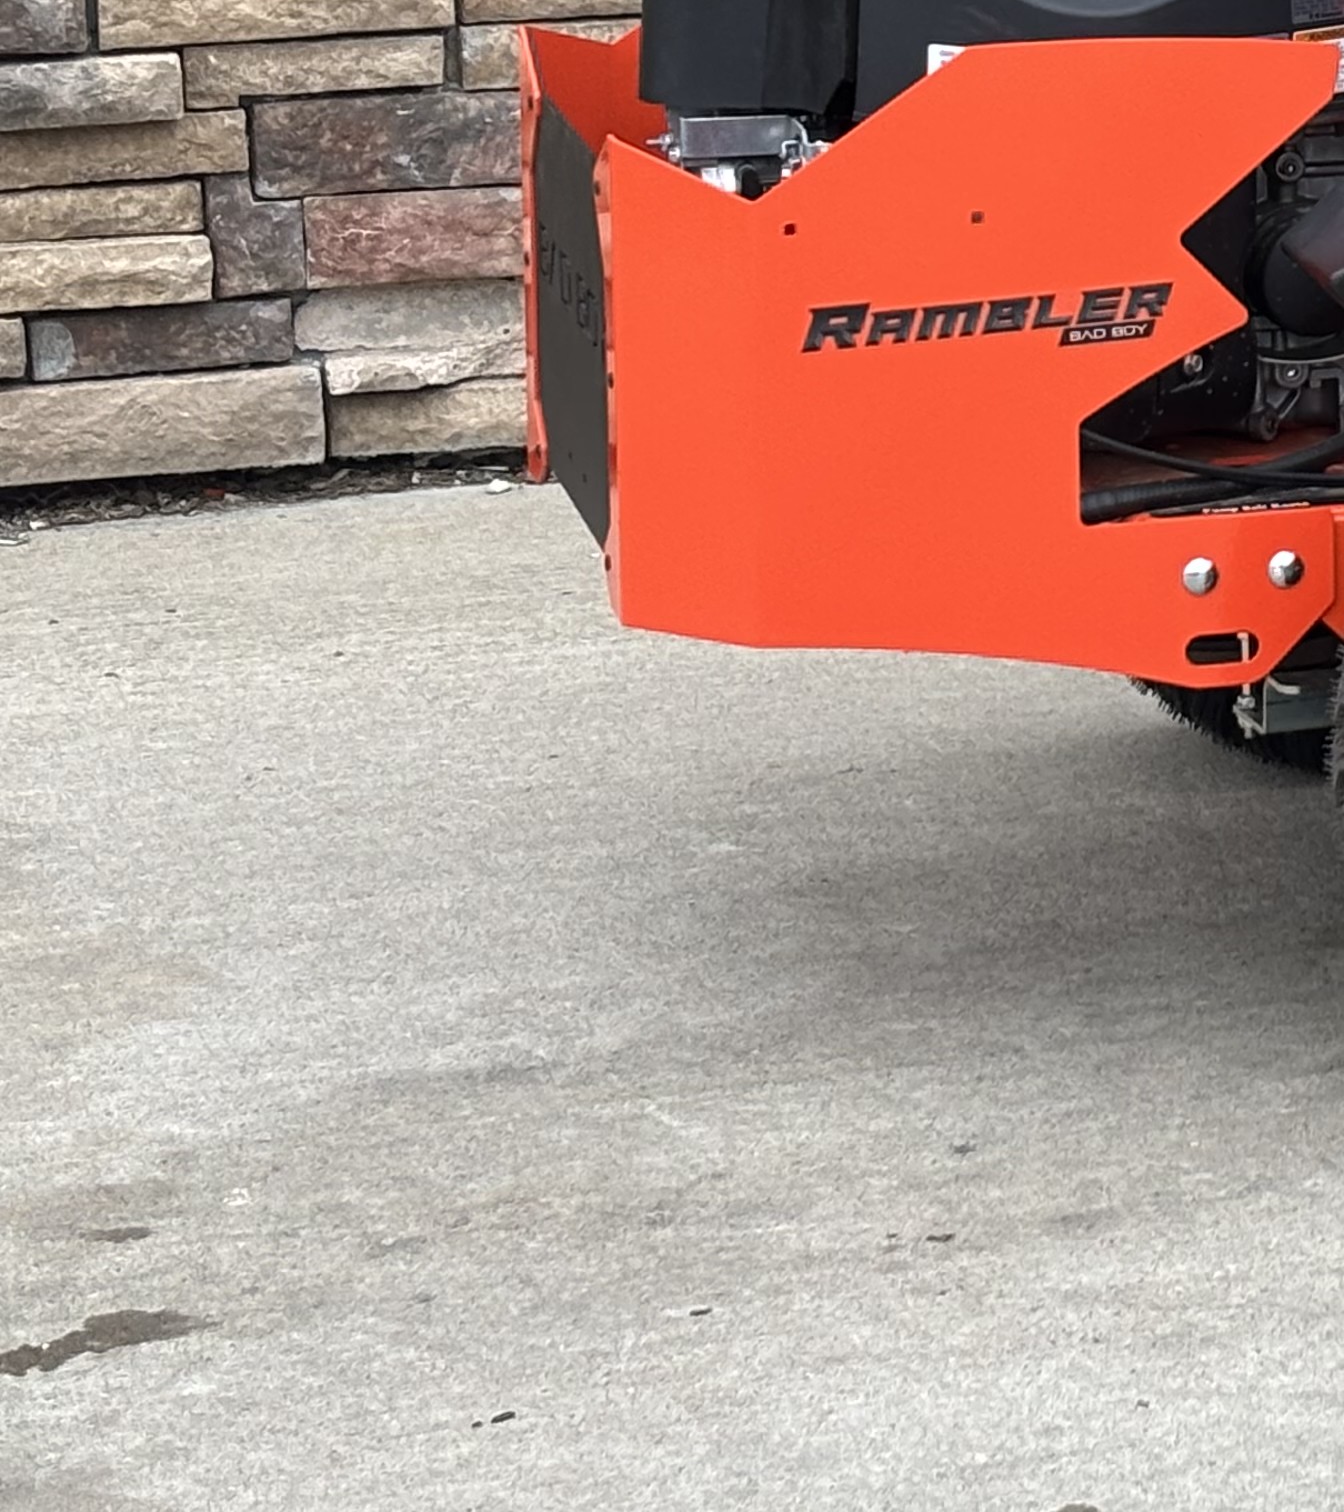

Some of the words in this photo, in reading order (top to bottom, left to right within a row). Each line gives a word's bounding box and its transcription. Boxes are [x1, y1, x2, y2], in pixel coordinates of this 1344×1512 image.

[800, 281, 1174, 353] RAMBLER
[1069, 328, 1107, 342] BAD
[1111, 323, 1148, 338] BOY
